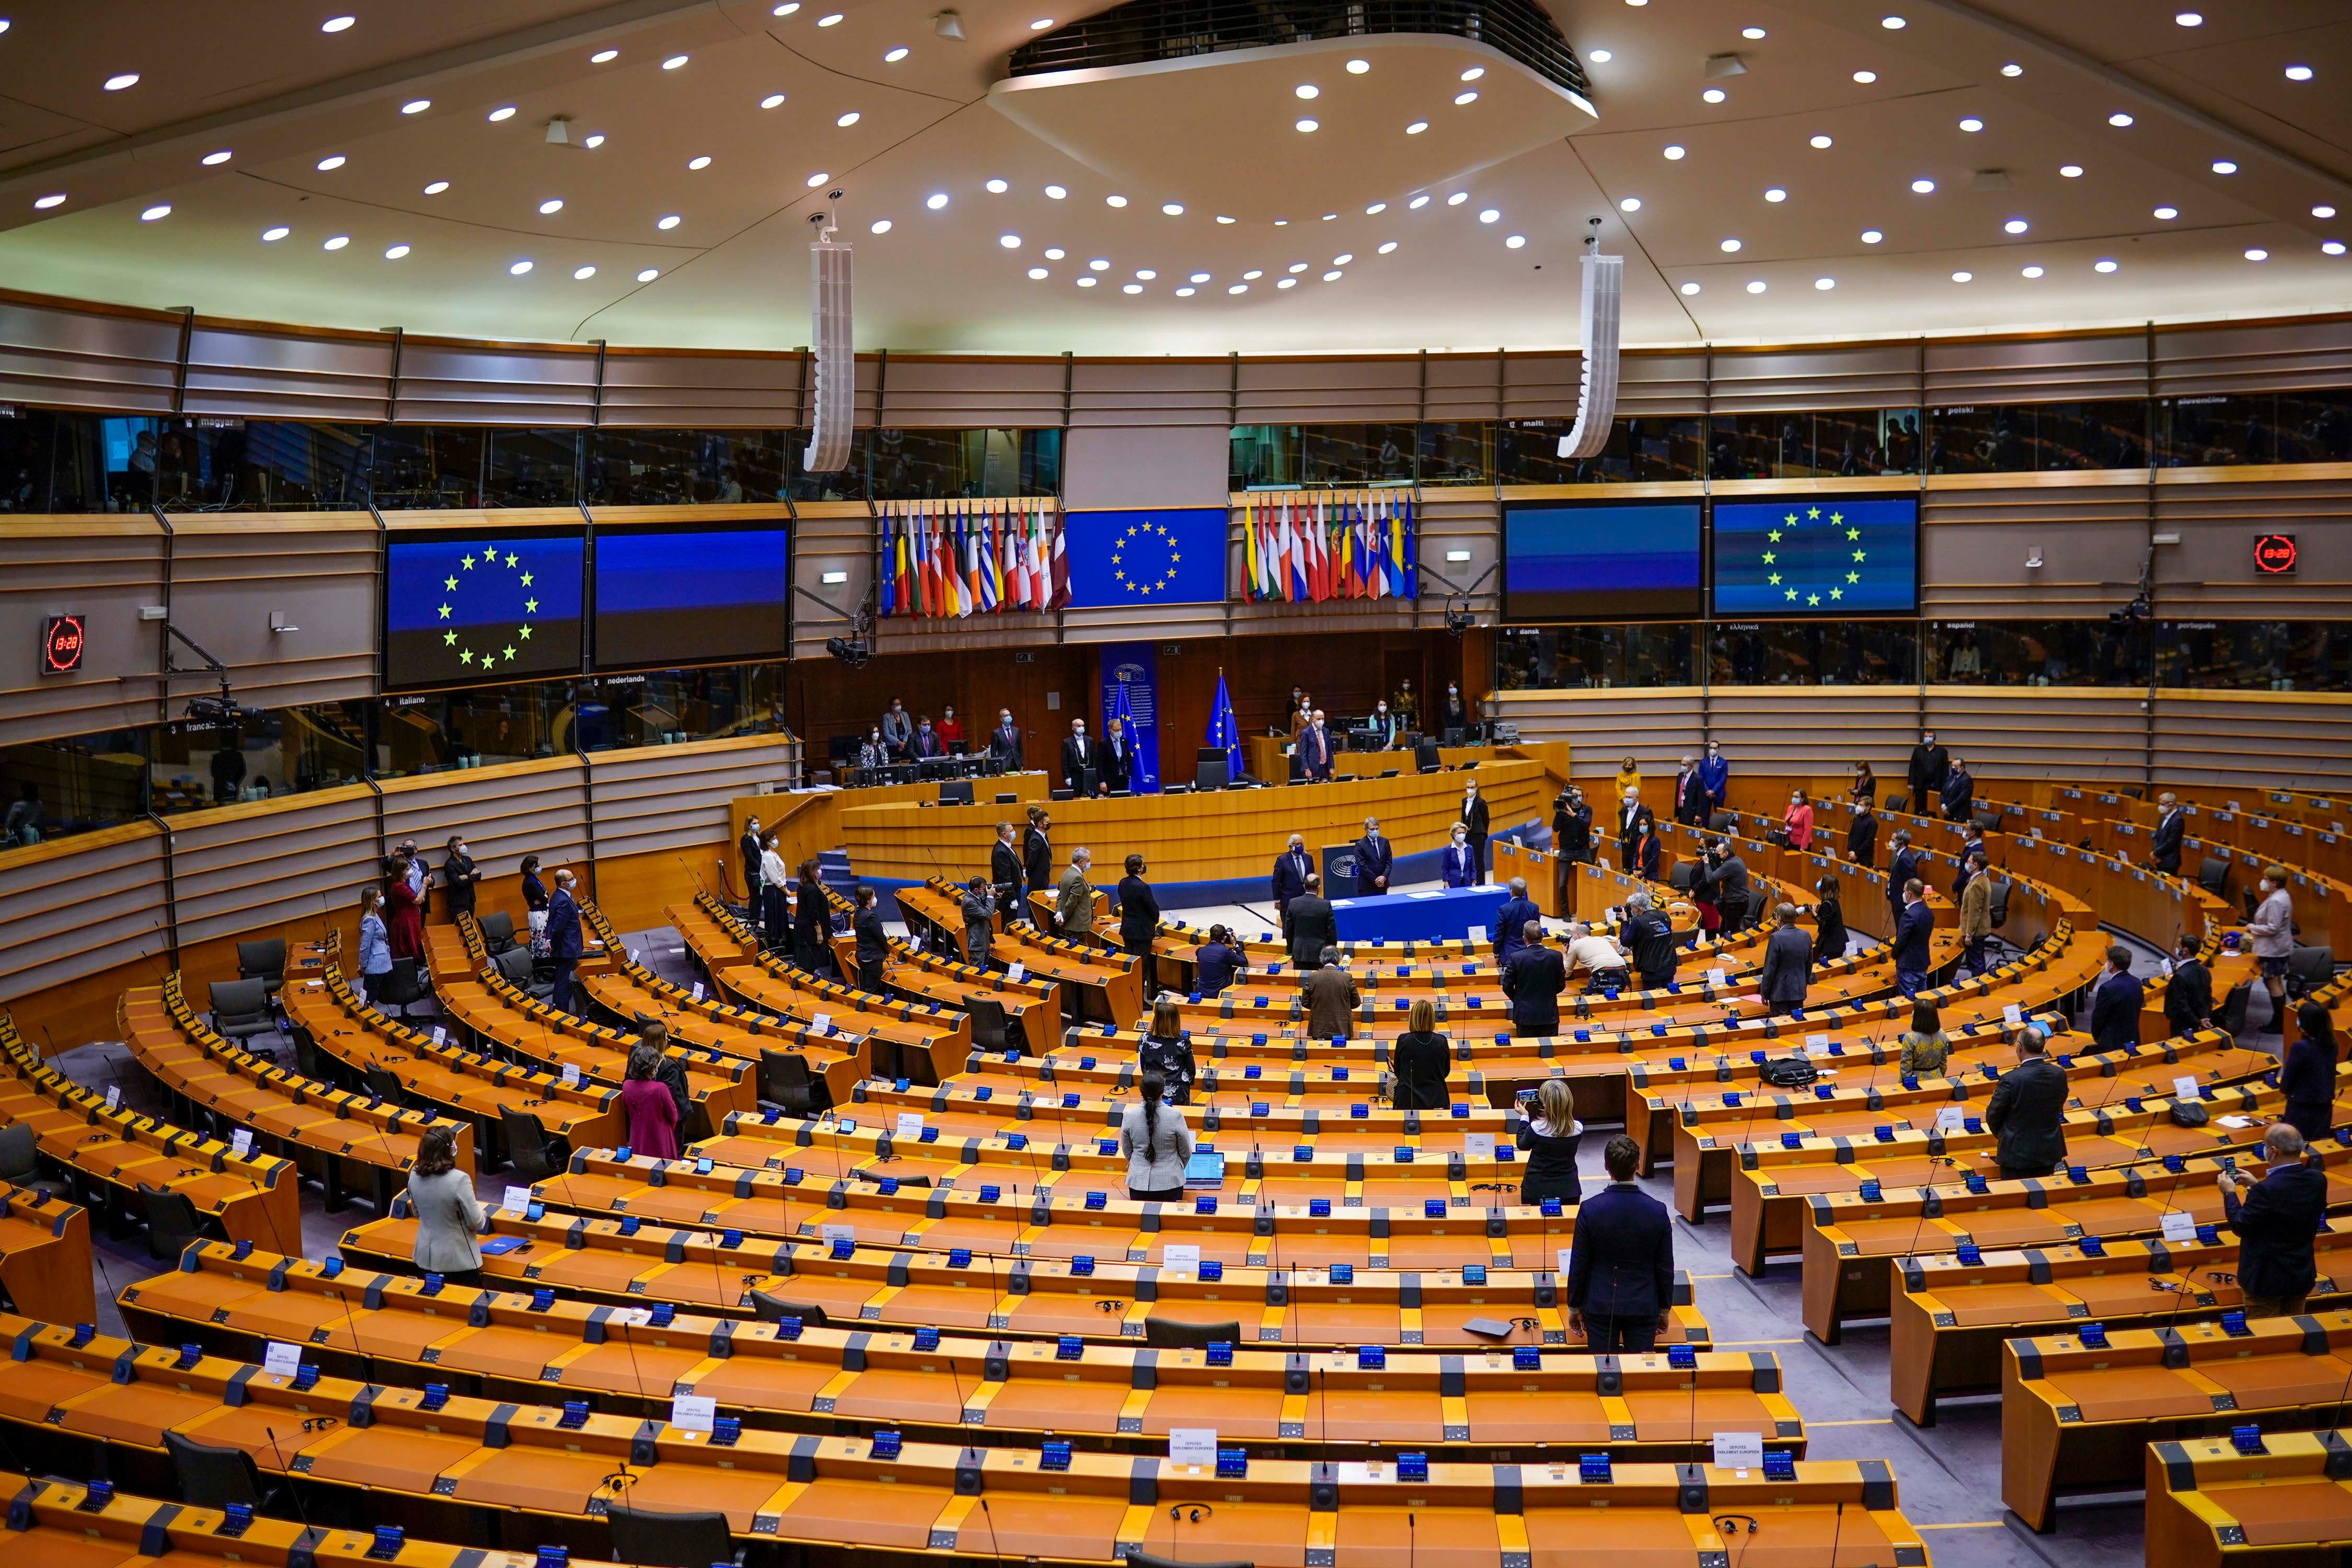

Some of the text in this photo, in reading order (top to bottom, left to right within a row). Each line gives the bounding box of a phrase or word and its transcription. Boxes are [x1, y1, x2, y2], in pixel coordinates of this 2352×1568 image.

[1948, 407, 1974, 415] polski
[201, 418, 234, 428] magyar
[55, 635, 78, 650] 13:28
[607, 676, 645, 685] nederlands
[399, 696, 425, 705] italiano
[171, 726, 176, 734] 3
[2107, 794, 2117, 803] 217
[1824, 802, 1832, 811] 129
[1979, 801, 1989, 810] 172
[2014, 806, 2024, 815] 173
[1887, 812, 1895, 821] 131
[2050, 813, 2060, 822] 174
[1762, 818, 1769, 827] 89
[1919, 819, 1929, 828] 132
[1694, 830, 1700, 838] 53
[1954, 825, 1964, 834] 133
[1594, 835, 1599, 844] 24
[1823, 831, 1830, 839] 91
[1724, 836, 1731, 845] 54
[2026, 839, 2035, 848] 134
[1755, 844, 1762, 852] 55
[1820, 858, 1827, 867] 56
[1597, 870, 1600, 879] 3
[1848, 866, 1855, 875] 57
[1623, 878, 1627, 887] 4
[1873, 874, 1878, 884] 58
